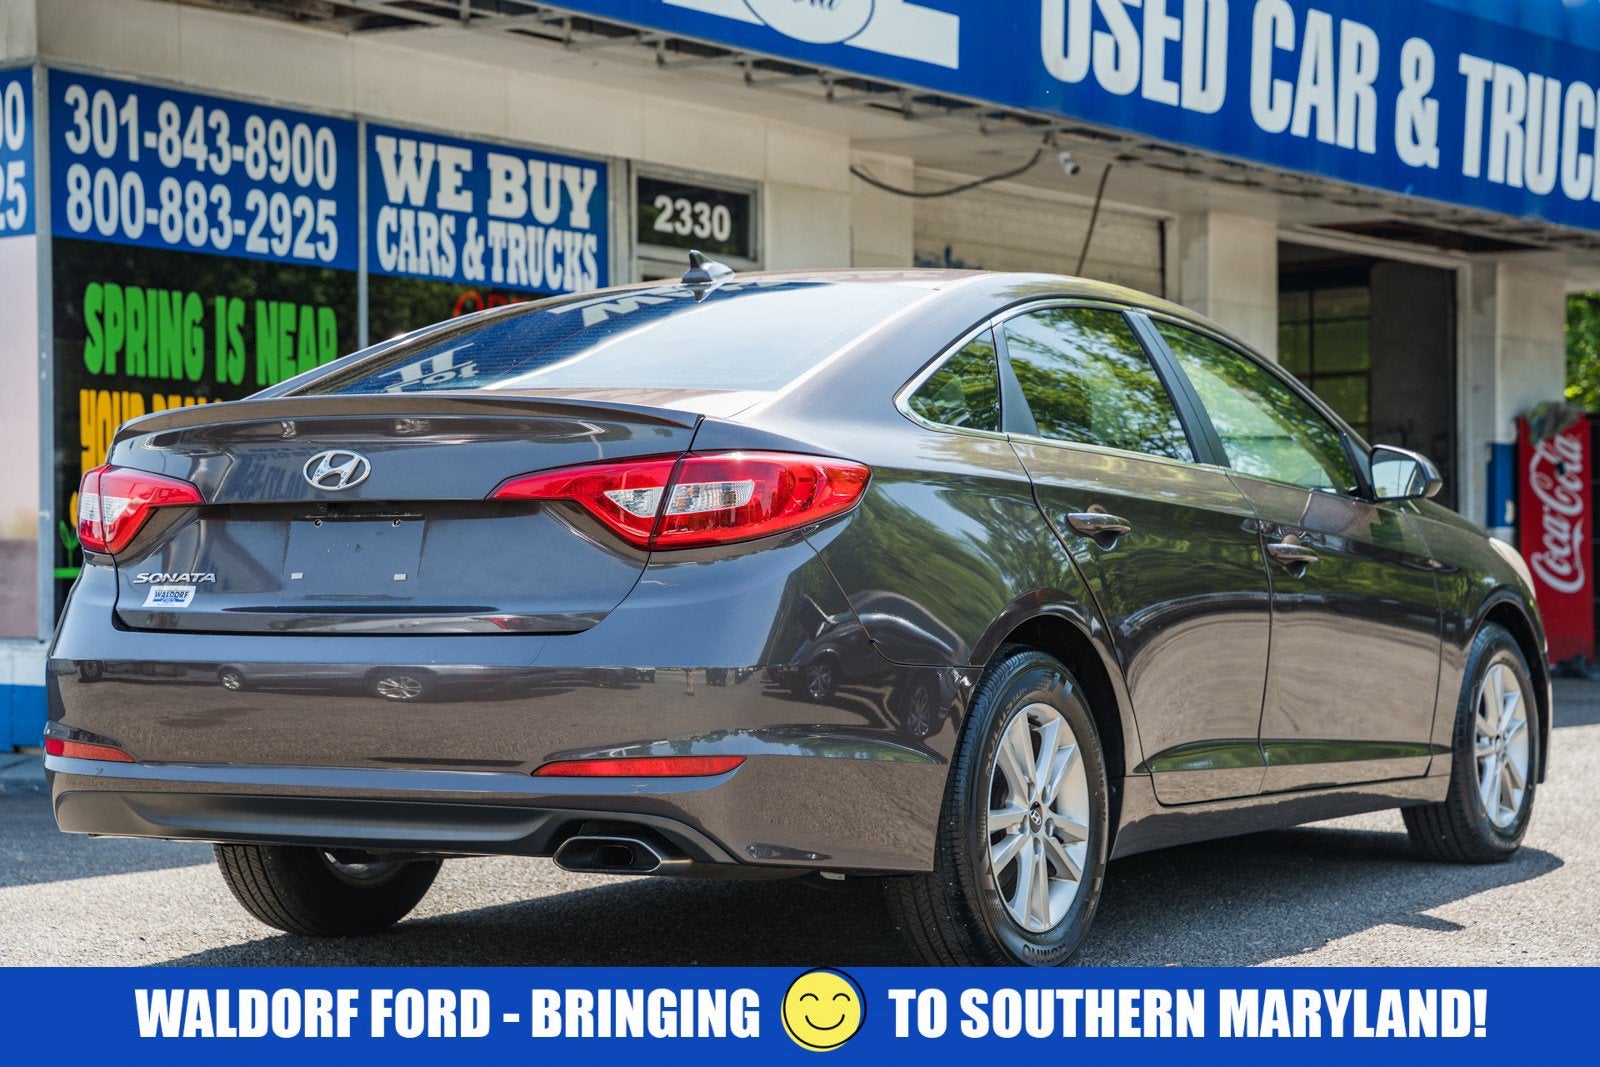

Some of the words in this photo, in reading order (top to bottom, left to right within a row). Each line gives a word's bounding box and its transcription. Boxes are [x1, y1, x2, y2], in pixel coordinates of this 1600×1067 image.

[0, 80, 25, 151] 0
[64, 83, 338, 191] 301-843-8900
[1040, 0, 1229, 113] USED
[1250, 0, 1379, 154] CAR
[1395, 37, 1441, 169] &
[1458, 53, 1600, 202] TRUC
[0, 160, 27, 230] 5
[66, 162, 339, 263] 800-883-2925
[374, 135, 473, 213] WE
[488, 152, 597, 229] BUY
[653, 194, 732, 242] 2330
[376, 205, 457, 278] CARS
[462, 217, 485, 281] &
[488, 220, 599, 293] TRUCKS
[83, 282, 205, 382] SPRING
[214, 295, 246, 385] IS
[133, 572, 217, 584] SONATA
[154, 589, 190, 600] WALDORF
